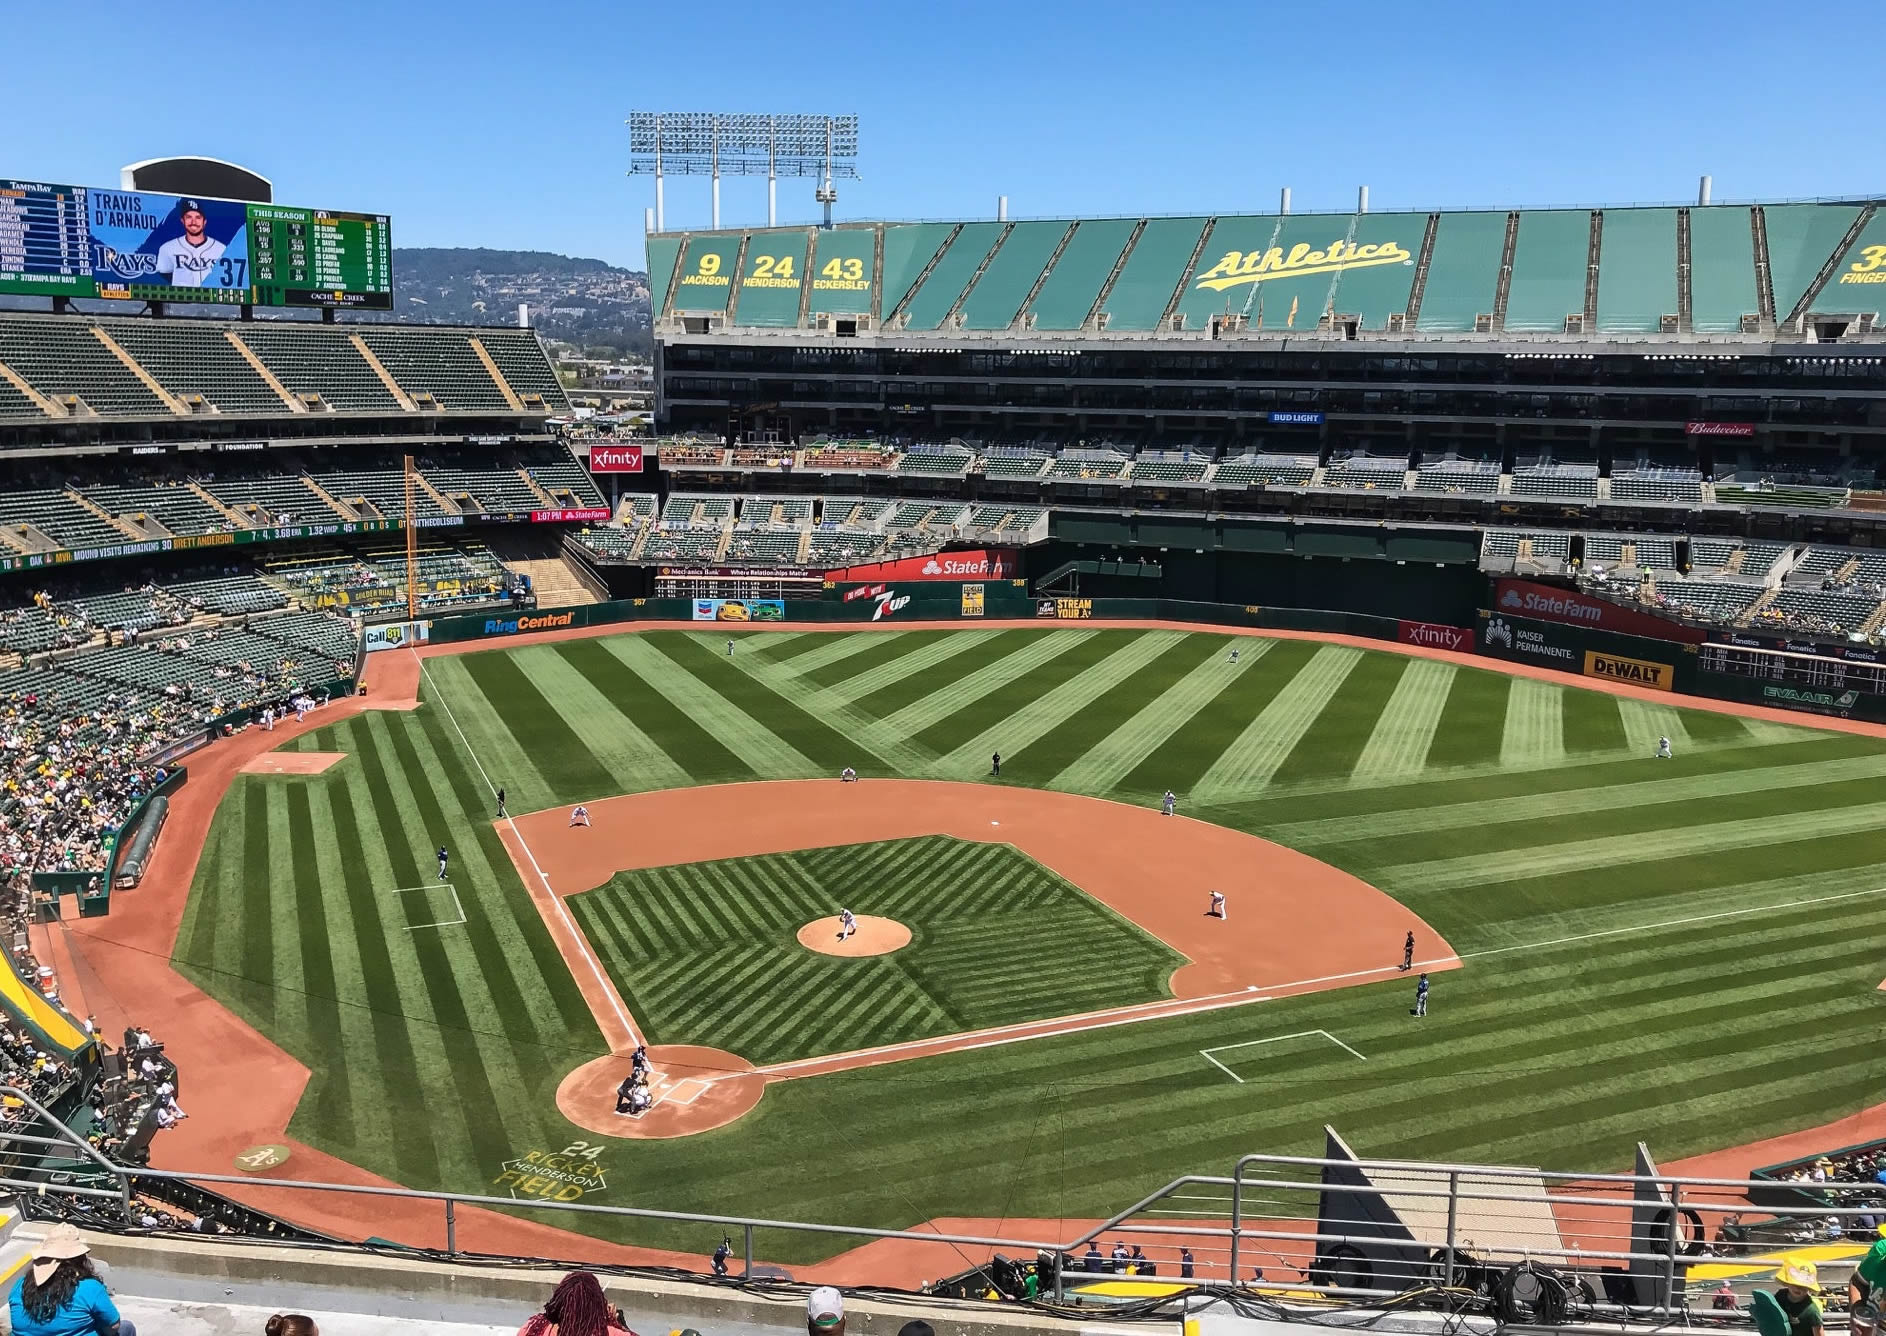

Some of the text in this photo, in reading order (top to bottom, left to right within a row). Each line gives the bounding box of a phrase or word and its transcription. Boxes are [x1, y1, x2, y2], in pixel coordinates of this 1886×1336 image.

[10, 182, 36, 191] TAMPA
[94, 193, 142, 212] TRAVIS
[96, 210, 156, 230] D'ARNAUD
[254, 209, 304, 220] THIS SEASON
[94, 245, 156, 279] RAYS
[699, 254, 721, 275] 9
[753, 255, 794, 278] 24
[1196, 240, 1404, 283] Athletics
[1851, 245, 1886, 272] 3
[220, 258, 246, 287] 37
[822, 258, 863, 280] 43
[682, 275, 729, 286] JACKSON
[743, 278, 800, 288] HENDERSON
[813, 279, 870, 290] ECKERSLEY
[1293, 414, 1319, 422] LIGHT
[1688, 423, 1751, 434] Budweiser
[594, 451, 639, 468] xfinity
[537, 511, 550, 520] 1:07
[551, 511, 561, 520] PM
[275, 529, 290, 538] 3.68
[309, 526, 323, 535] 1.32
[344, 524, 352, 532] 45
[30, 556, 43, 567] OAK
[74, 548, 98, 560] MOUND
[99, 546, 122, 557] VISITS
[123, 542, 159, 555] REMAINING
[162, 540, 172, 550] 30
[173, 537, 196, 549] BRETT
[197, 534, 234, 547] ANDERSON
[944, 560, 1012, 574] StateFarm
[872, 591, 910, 621] 7UP
[1057, 600, 1092, 609] STREAM
[1057, 609, 1079, 618] YOUR
[1524, 593, 1601, 621] StateFarm
[485, 613, 572, 633] RingCentral
[367, 627, 401, 644] Call 811
[1409, 625, 1462, 649] xfinity
[1517, 629, 1544, 643] KAISER
[1731, 638, 1760, 646] Fanatics
[1516, 642, 1572, 659] PERMANENTE
[1787, 643, 1817, 653] Fanatics
[1845, 650, 1876, 660] Fanatics
[1764, 686, 1834, 705] EVA AIR
[237, 1148, 279, 1166] A's
[560, 1141, 606, 1160] 24
[524, 1150, 610, 1177] RICKEY
[512, 1161, 598, 1187] HENDERSON
[492, 1170, 584, 1200] FIELD
